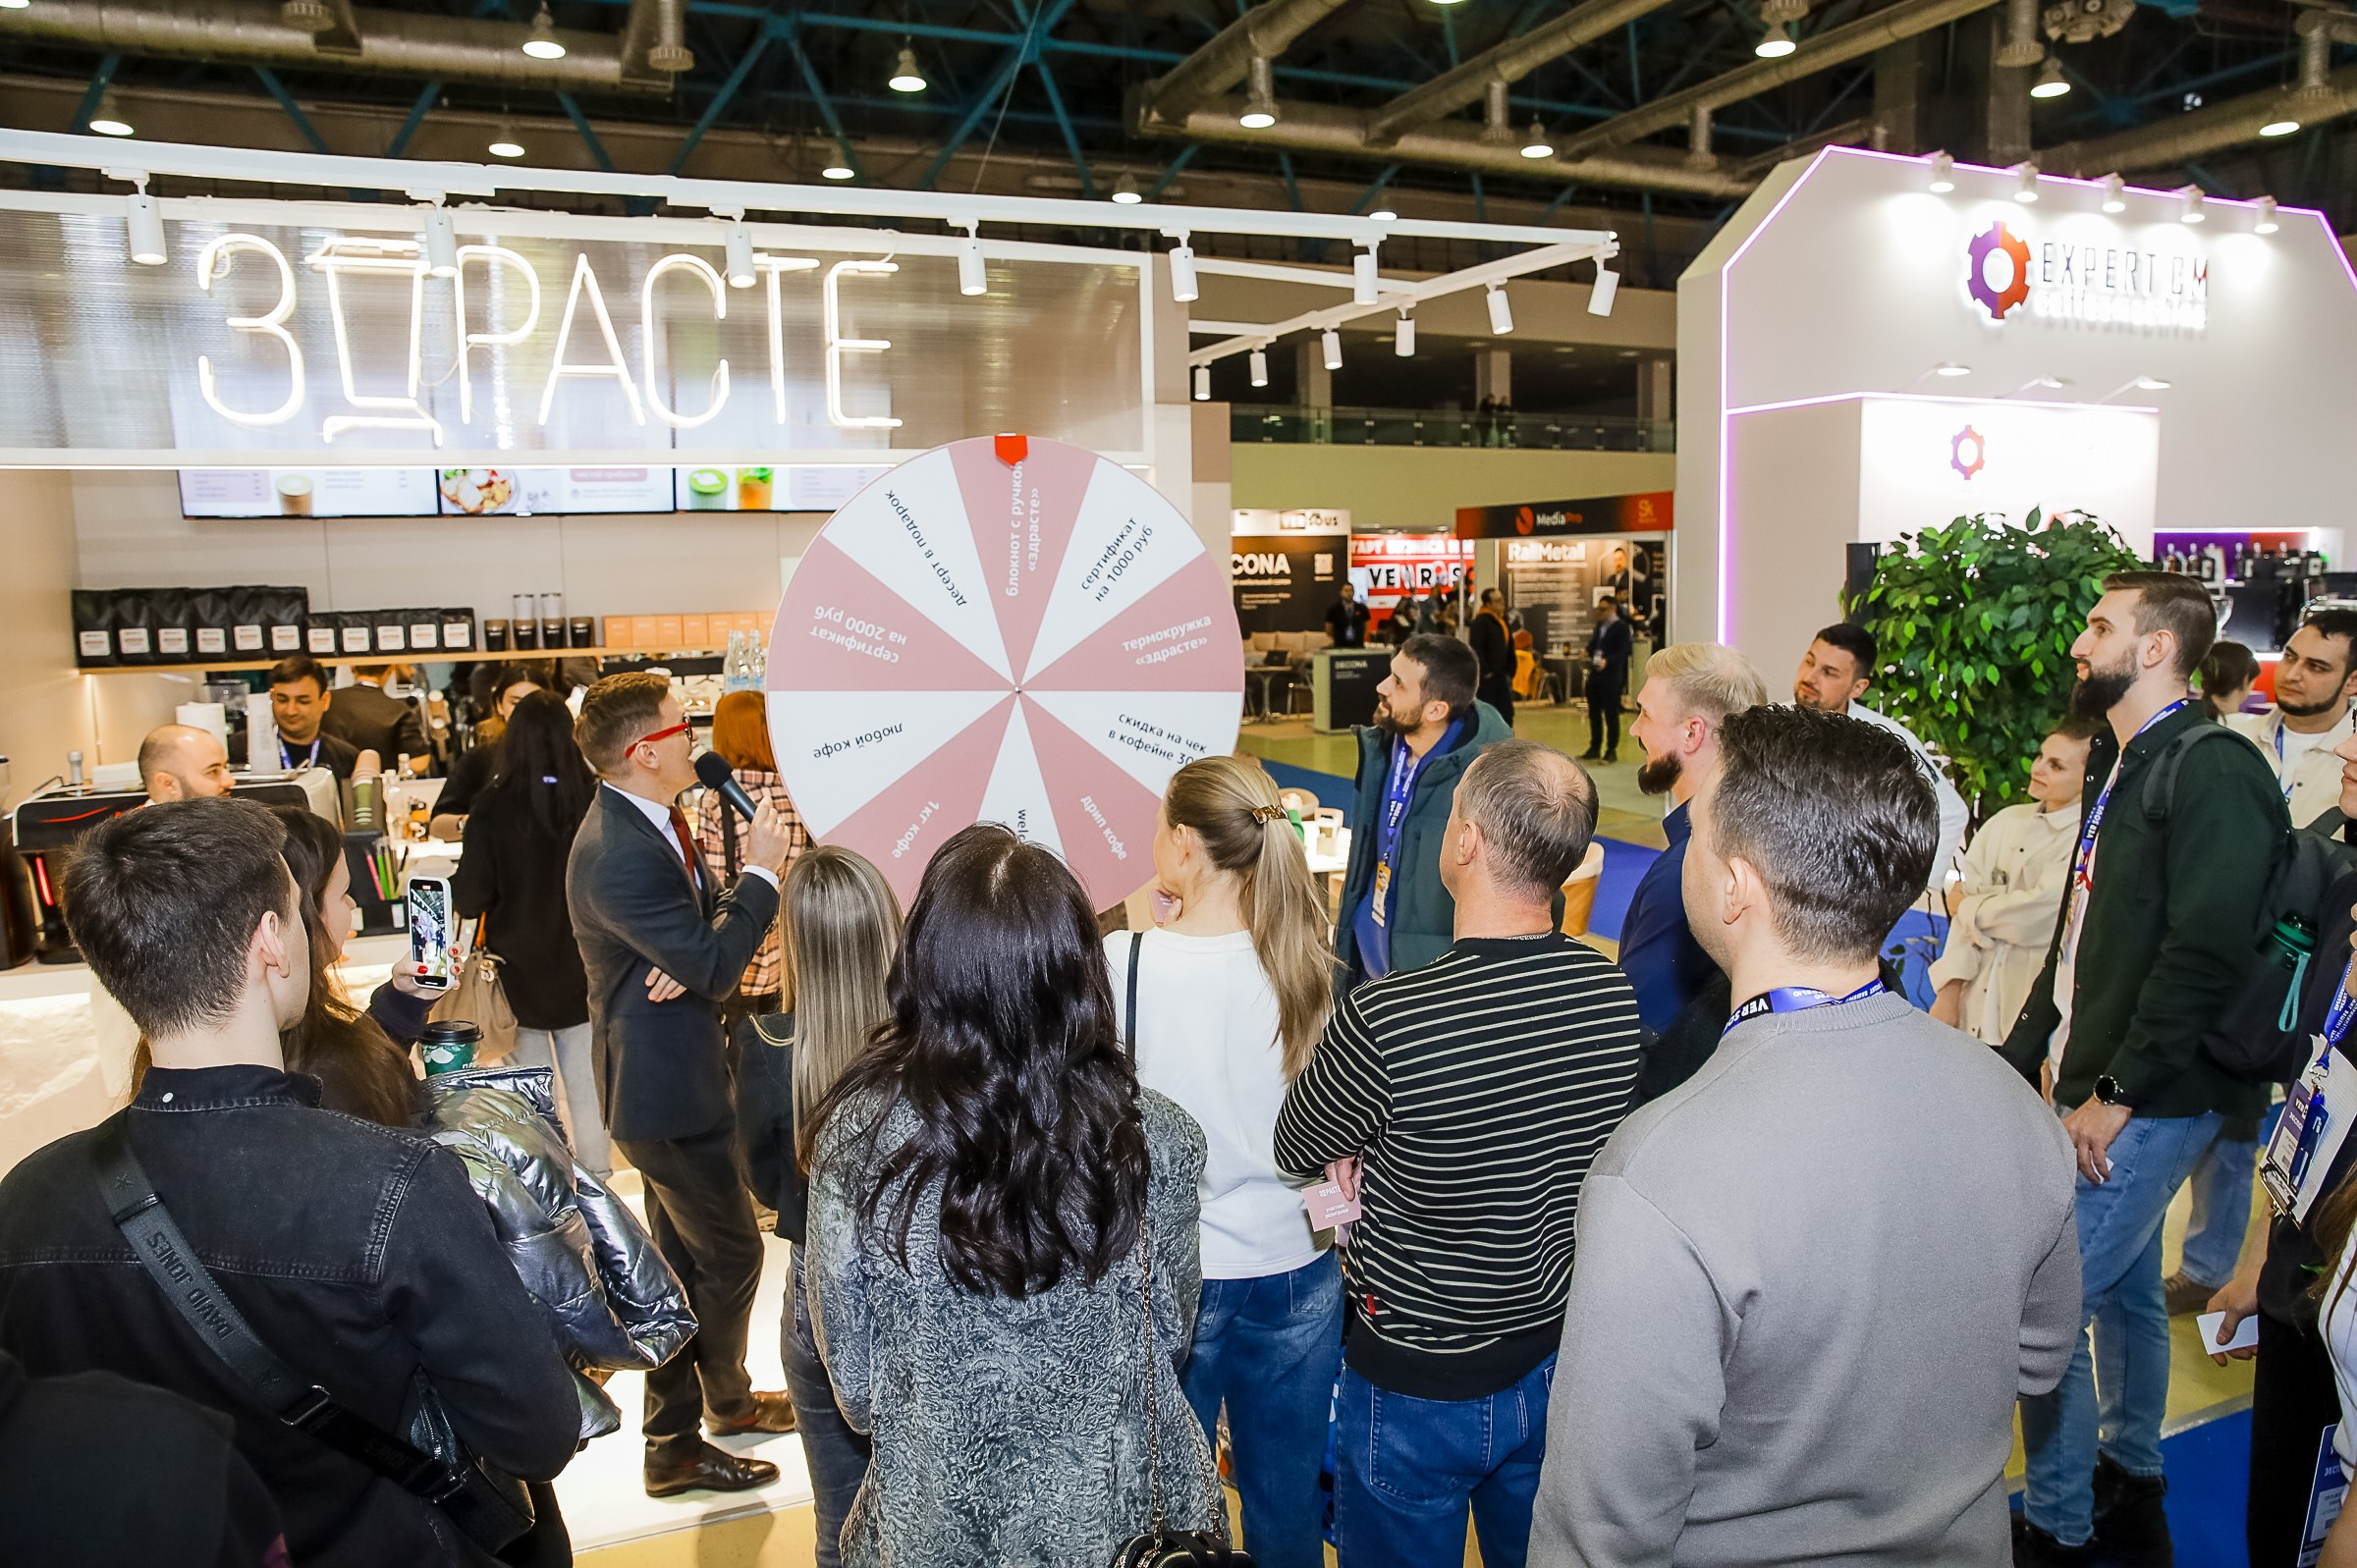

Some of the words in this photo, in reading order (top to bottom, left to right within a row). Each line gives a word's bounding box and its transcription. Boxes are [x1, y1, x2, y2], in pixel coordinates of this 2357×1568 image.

[2043, 243, 2156, 293] EXPERT
[2171, 255, 2209, 297] CM
[197, 232, 904, 447] ЗДРАСТЕ
[885, 489, 926, 547] подарок
[924, 549, 934, 559] в
[931, 561, 968, 610] десерт
[1028, 488, 1041, 571] «здрасте»
[1006, 532, 1020, 597] блокнот
[1081, 516, 1137, 590] сертификат
[1095, 585, 1110, 602] на
[1107, 550, 1134, 582] 1000
[1133, 524, 1153, 553] руб
[812, 605, 844, 622] руб
[845, 616, 886, 641] 2000
[808, 624, 900, 664] сертификат
[888, 630, 907, 645] на
[1122, 616, 1212, 652] термокружка
[1135, 636, 1208, 666] «здрасте»
[812, 738, 851, 759] кофе
[854, 723, 904, 748] любой
[1108, 730, 1116, 738] в
[1119, 733, 1174, 760] кофейне
[1119, 713, 1164, 737] скидка
[1167, 732, 1181, 744] на
[1185, 738, 1207, 754] чек
[891, 824, 920, 859] кофе
[1079, 794, 1107, 828] дрип
[1102, 828, 1127, 861] кофе
[1741, 998, 1769, 1017] VER
[146, 1230, 193, 1284] JONES
[188, 1287, 236, 1340] DAVID
